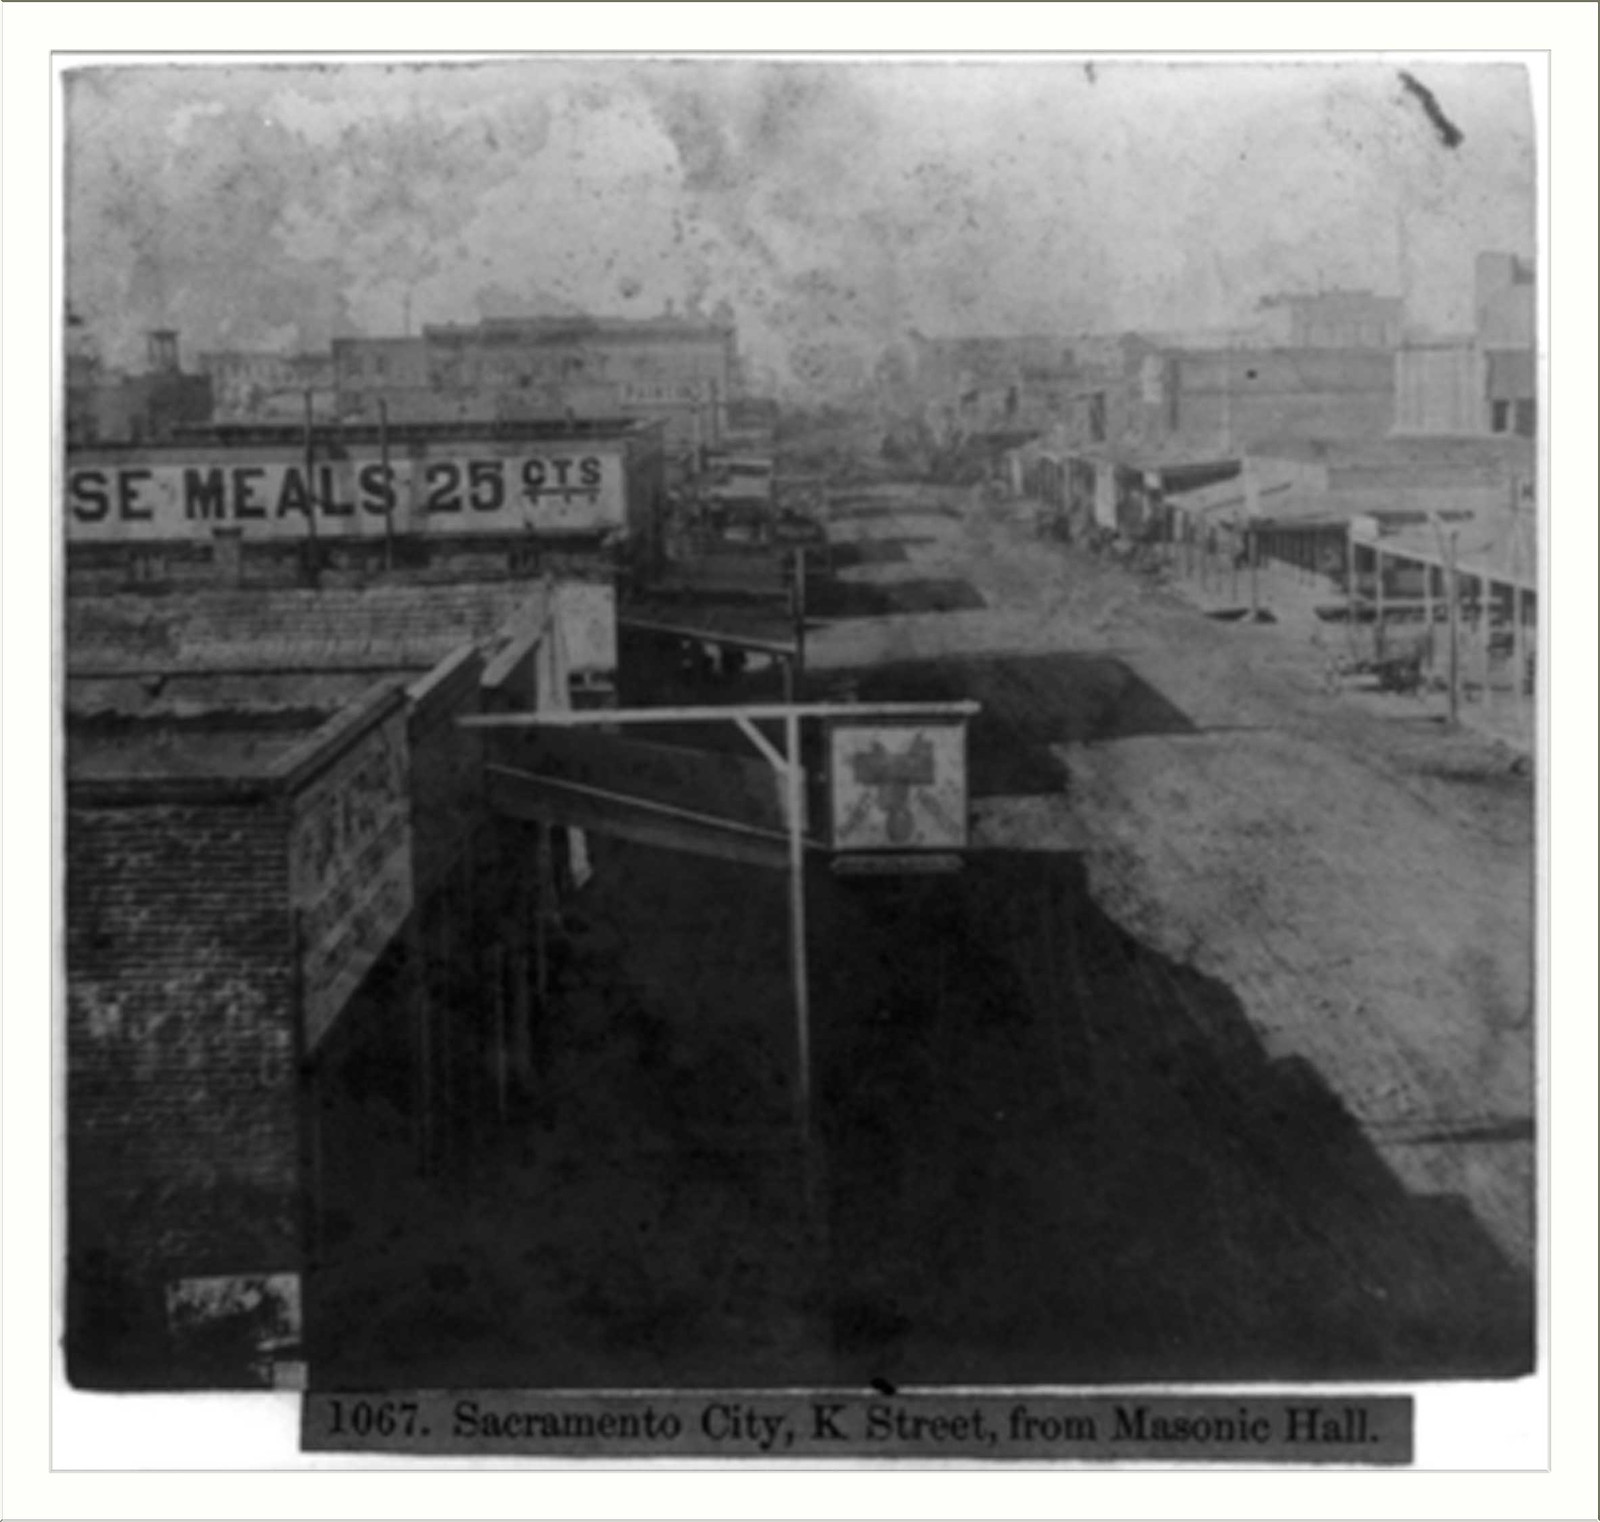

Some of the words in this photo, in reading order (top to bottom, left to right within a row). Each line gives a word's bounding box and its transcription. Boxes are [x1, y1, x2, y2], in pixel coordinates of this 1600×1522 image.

[72, 470, 154, 522] SE
[183, 463, 398, 520] MEALS
[425, 459, 504, 513] 25
[521, 457, 601, 487] CTS
